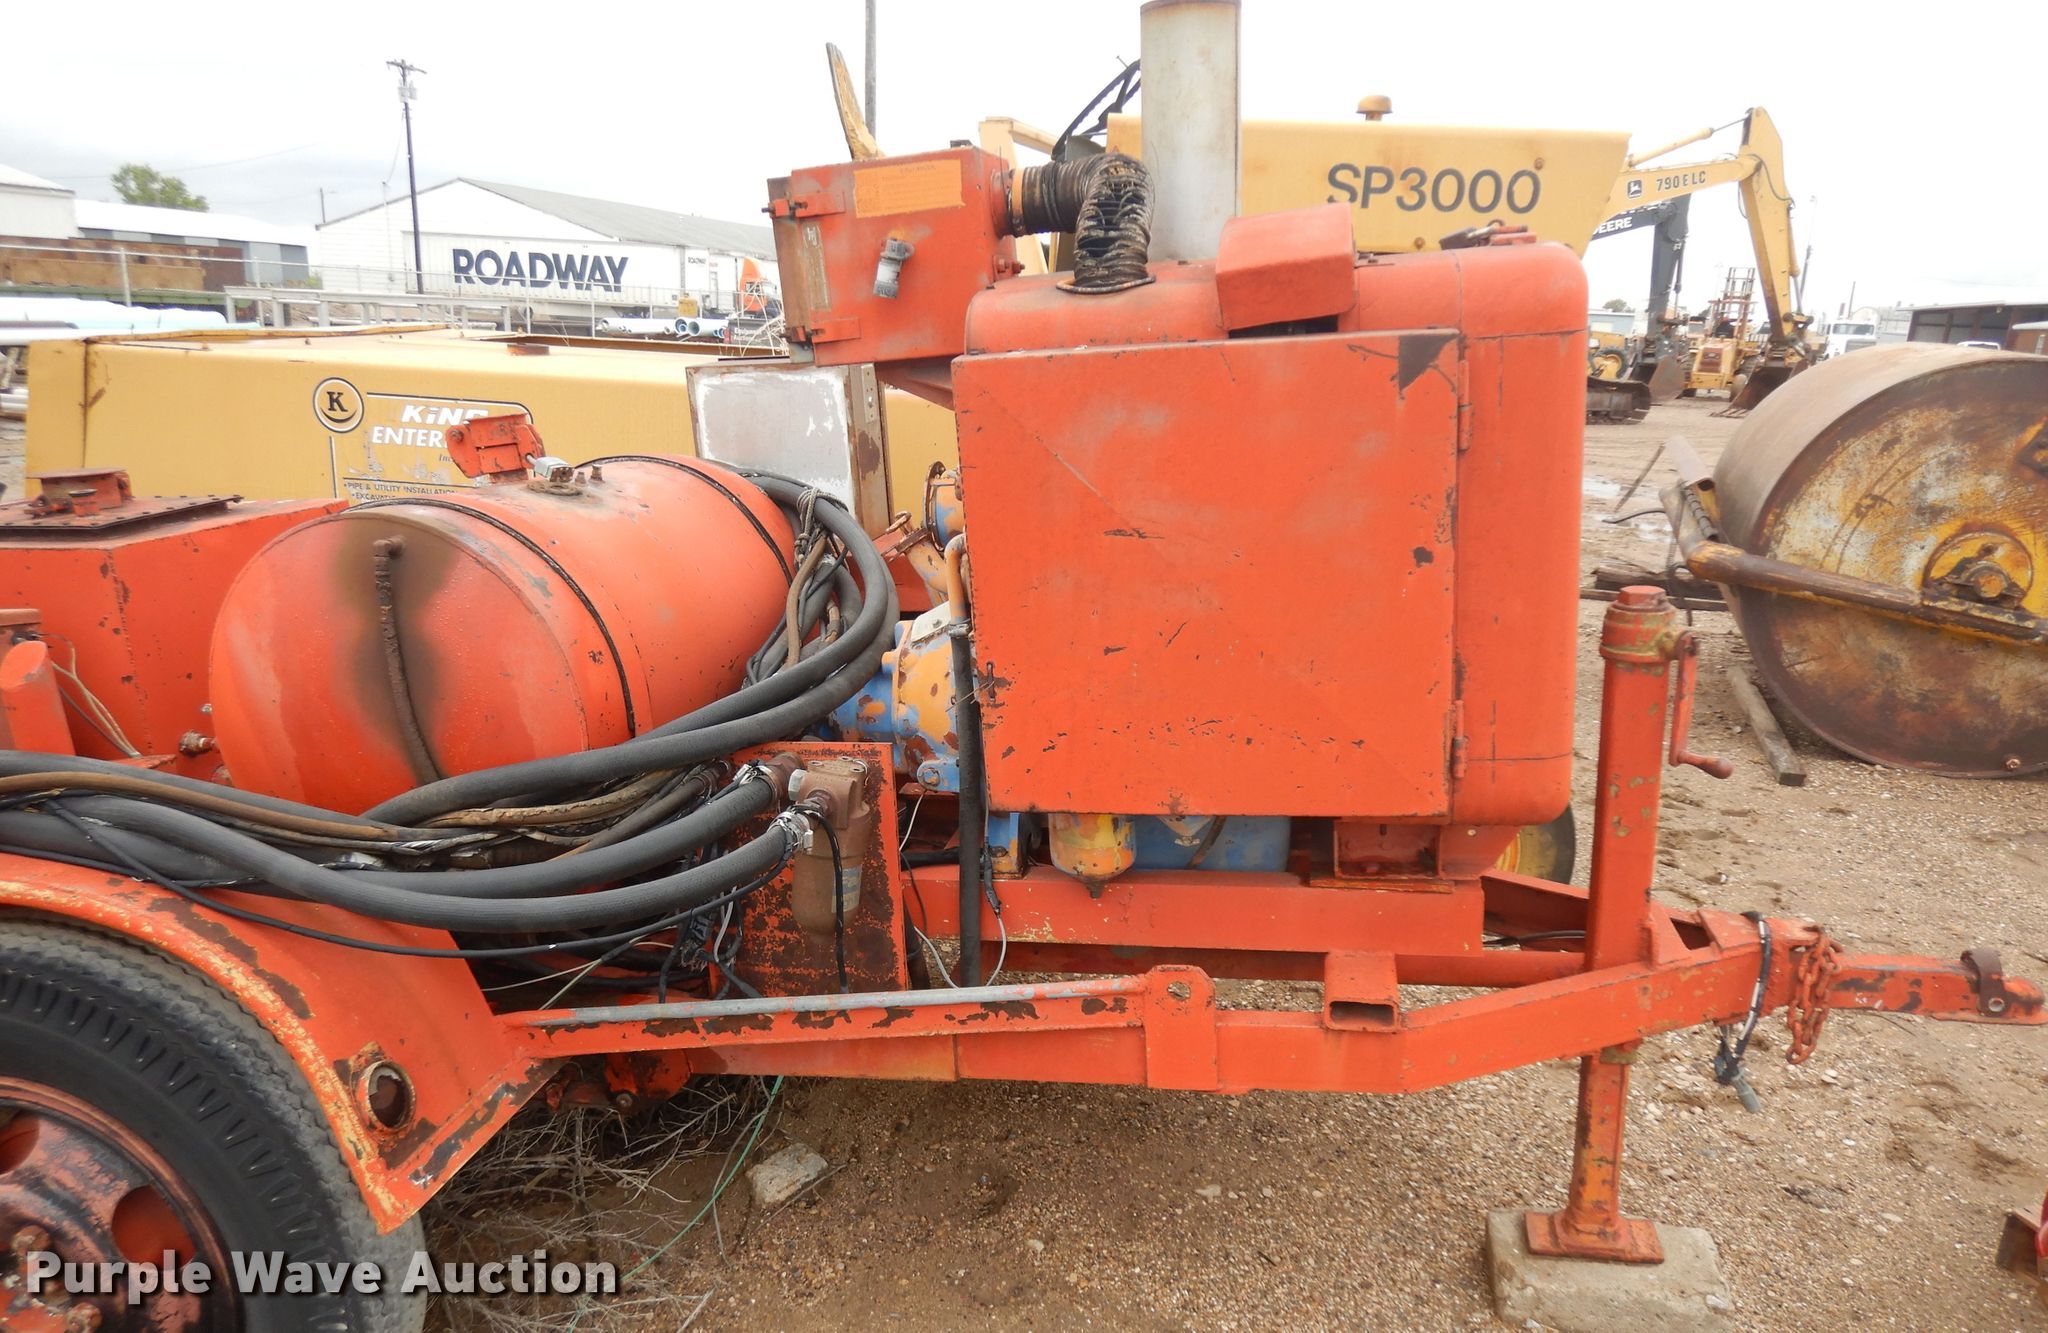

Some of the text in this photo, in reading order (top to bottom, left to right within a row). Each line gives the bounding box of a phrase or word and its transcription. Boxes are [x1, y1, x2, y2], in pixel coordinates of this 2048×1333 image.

[1327, 163, 1541, 214] SP3000
[452, 248, 629, 293] ROADWAY
[326, 391, 348, 412] K
